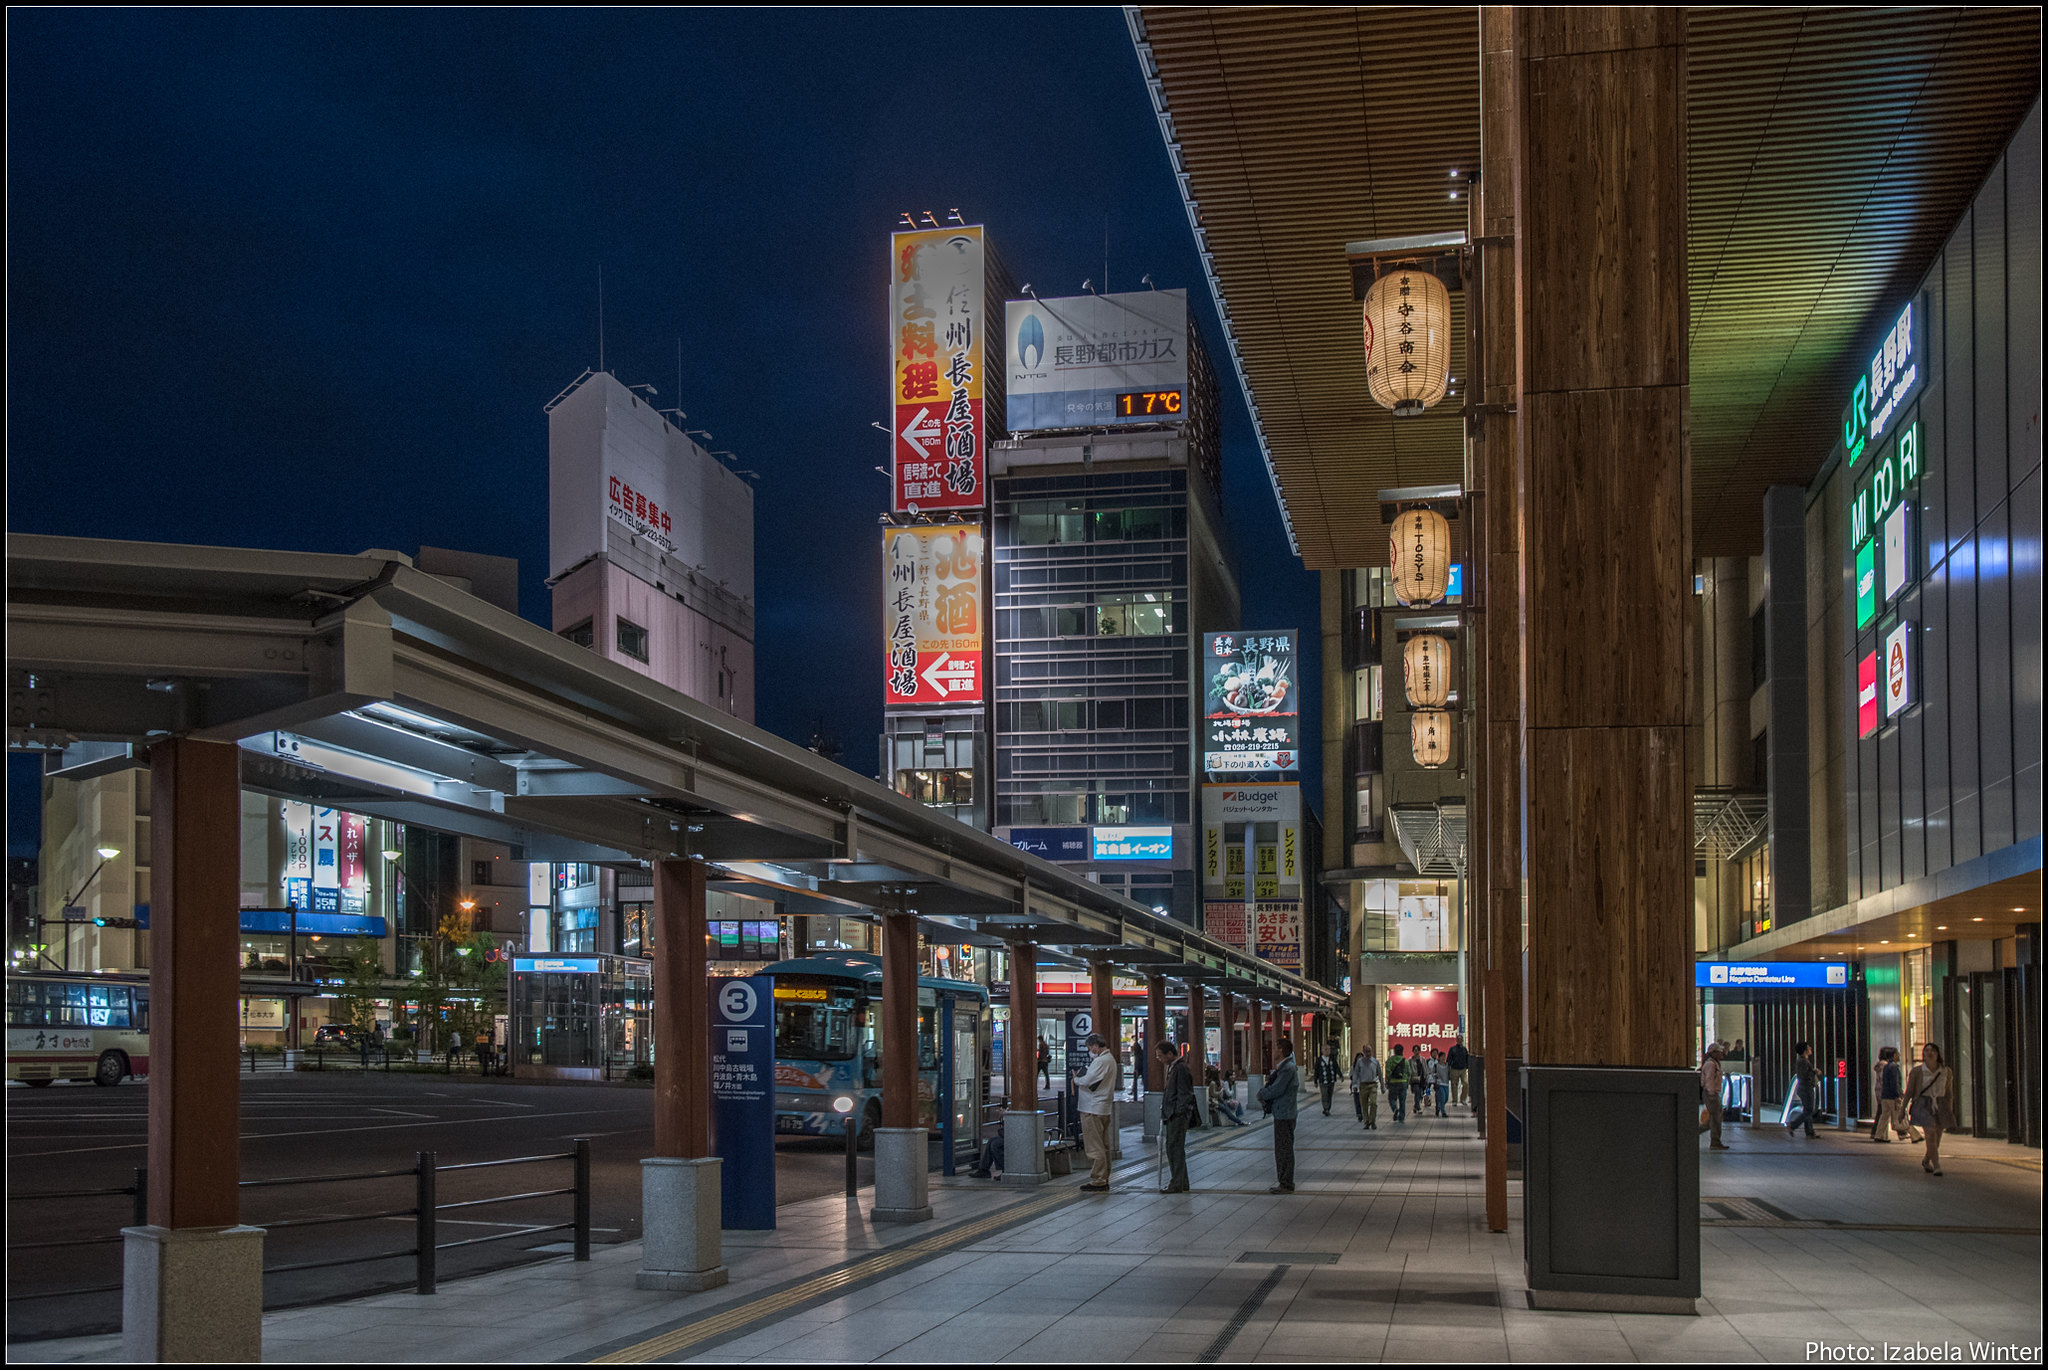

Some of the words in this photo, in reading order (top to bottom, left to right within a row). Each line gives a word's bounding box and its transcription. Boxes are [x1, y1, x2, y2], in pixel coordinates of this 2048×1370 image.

[1397, 302, 1417, 374] 守谷商会
[1053, 337, 1177, 366] 長野都市ガス
[1870, 302, 1912, 411] 長野駅
[1015, 372, 1048, 380] NTG
[1846, 374, 1867, 449] JR
[921, 418, 941, 429] この先
[921, 437, 941, 447] 160m
[903, 462, 941, 481] 信号渡って
[903, 481, 941, 500] 直進
[609, 476, 672, 535] 広告募集中
[624, 512, 635, 528] TEL
[1414, 534, 1424, 582] TOSYS
[922, 639, 949, 650] この先
[951, 639, 980, 649] 160m
[1215, 646, 1239, 655] 日本一
[1243, 636, 1291, 653] 長野県
[948, 679, 975, 692] 直進
[1211, 726, 1289, 743] 小林農場
[1222, 760, 1271, 769] 下の小道入る
[1237, 791, 1278, 804] Budget
[1095, 843, 1170, 855] 英会話イーオン
[1208, 829, 1217, 877] レンタカー
[1284, 829, 1294, 877] レンタカー
[1229, 888, 1243, 897] 3F
[1260, 888, 1274, 897] 3F
[1257, 903, 1299, 912] 長野新幹線
[726, 987, 749, 1014] 3
[1075, 1017, 1089, 1031] 4
[1395, 1022, 1457, 1039] 無印良品
[1420, 1043, 1432, 1052] B1
